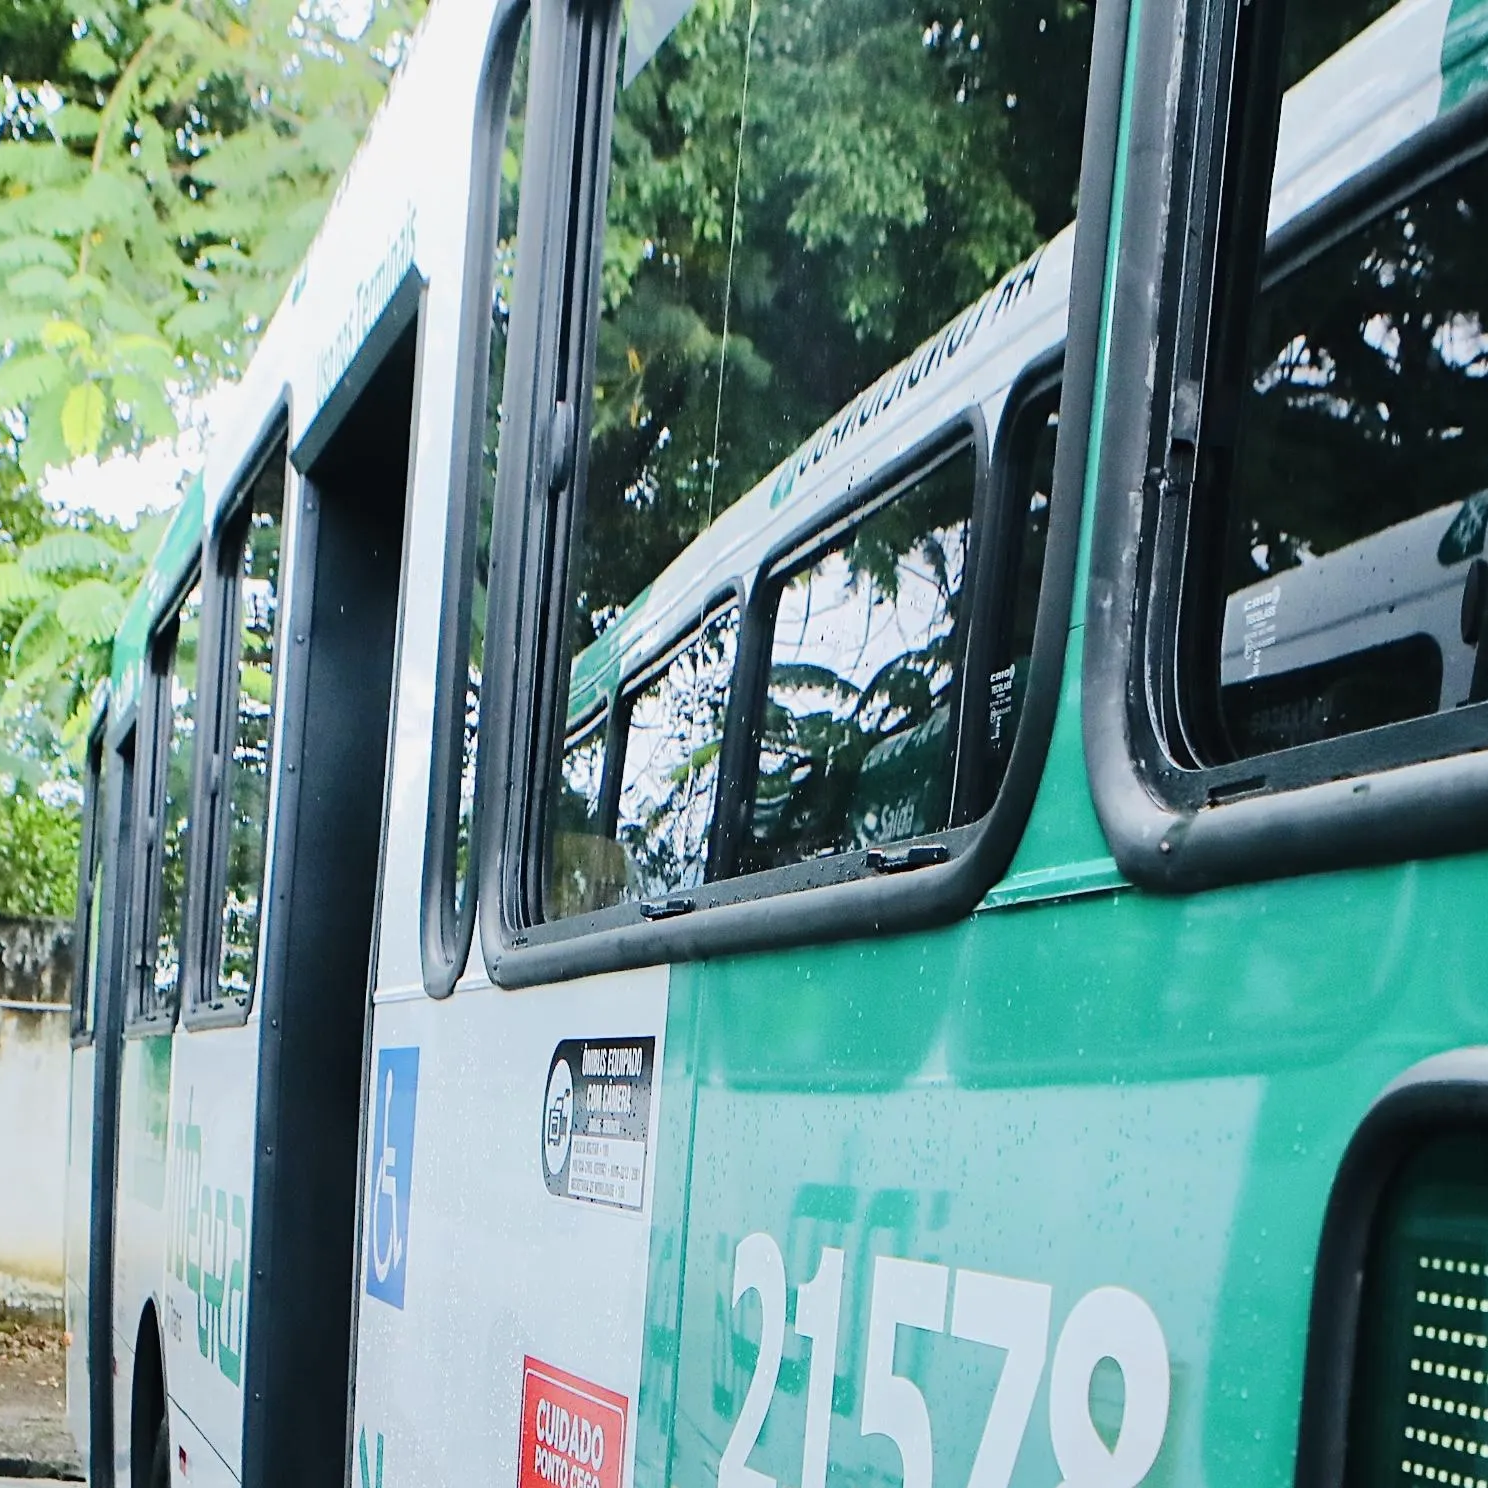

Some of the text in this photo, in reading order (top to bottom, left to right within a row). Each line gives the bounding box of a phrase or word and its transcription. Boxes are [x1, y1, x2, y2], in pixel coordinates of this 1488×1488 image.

[581, 1042, 643, 1078] ÔNIBUS EQUIPADO
[586, 1078, 632, 1113] COM CÂMERA
[535, 1398, 605, 1471] CUIDADO
